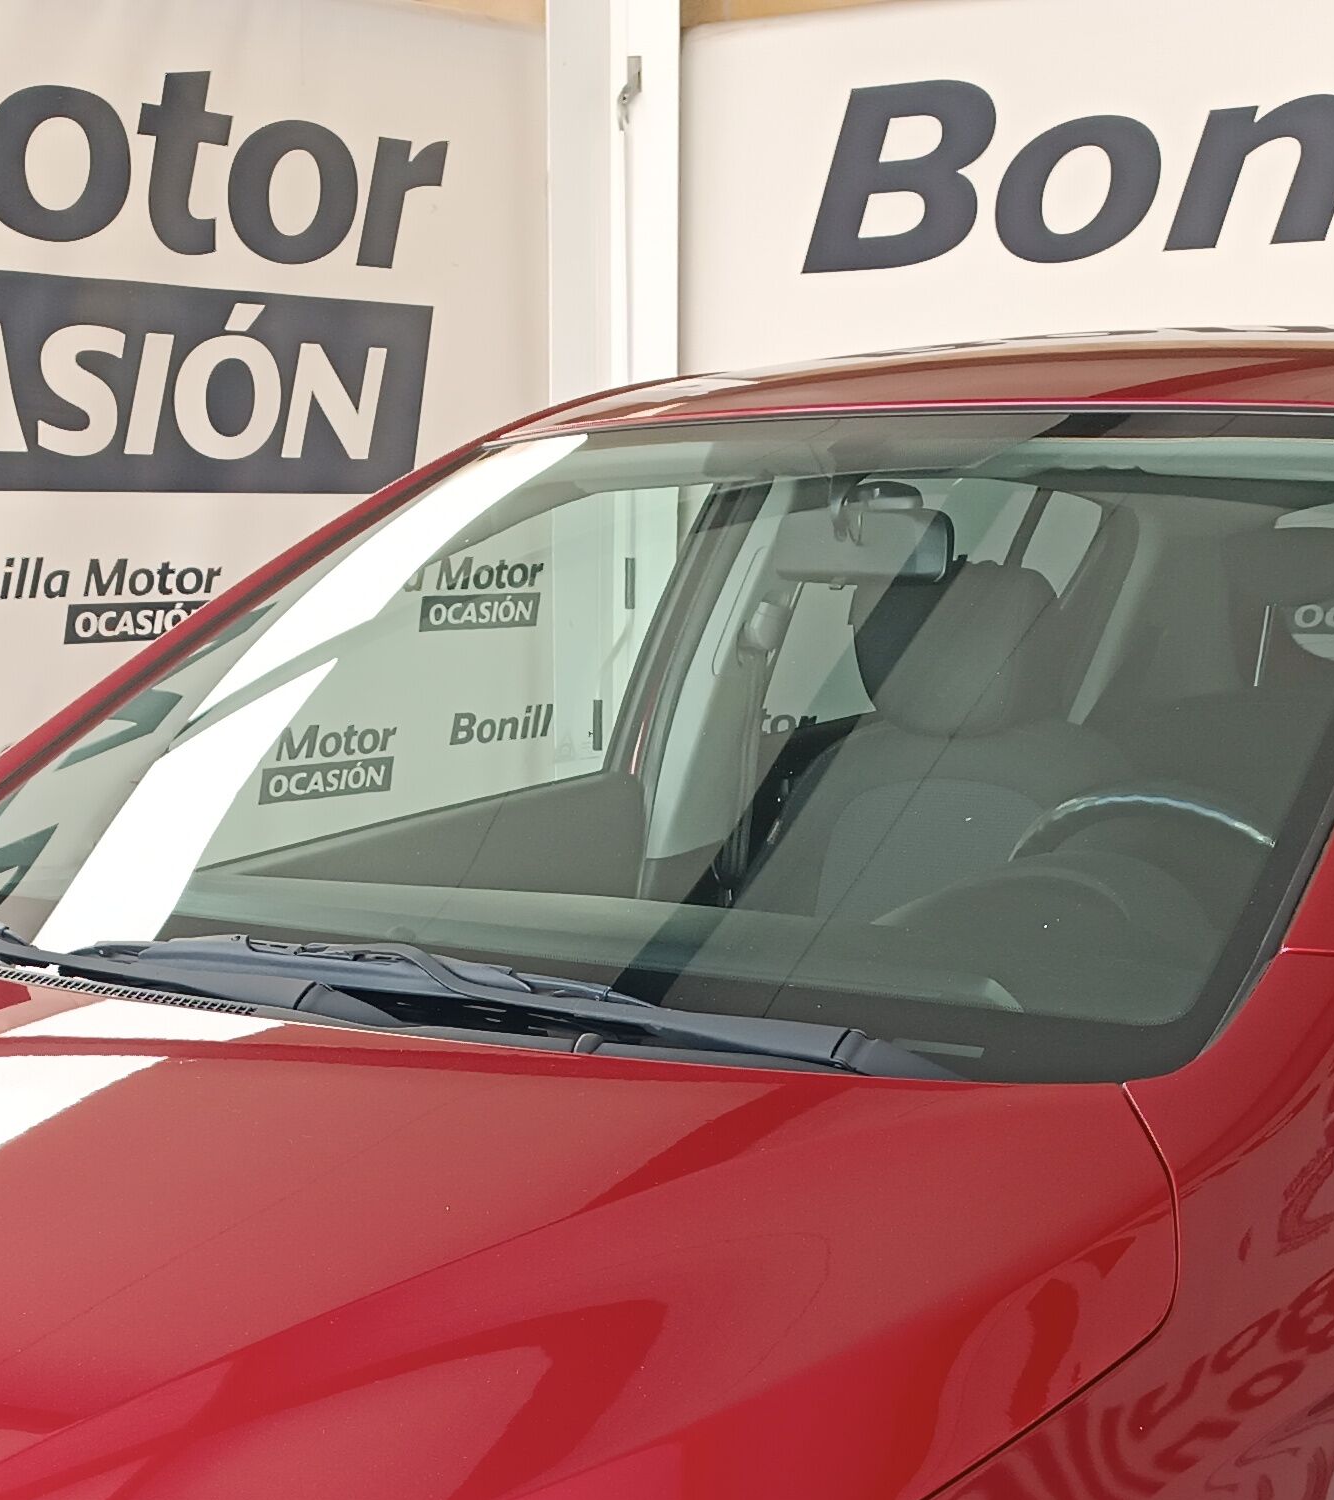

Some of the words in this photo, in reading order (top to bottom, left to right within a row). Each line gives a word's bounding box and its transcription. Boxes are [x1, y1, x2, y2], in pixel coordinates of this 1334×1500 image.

[84, 558, 223, 597] Motor
[435, 556, 544, 591] Motor
[74, 602, 202, 637] OCASIÓ
[428, 595, 533, 627] OCASIÓN
[275, 724, 398, 762] Motor
[268, 761, 387, 798] OCASIÓN
